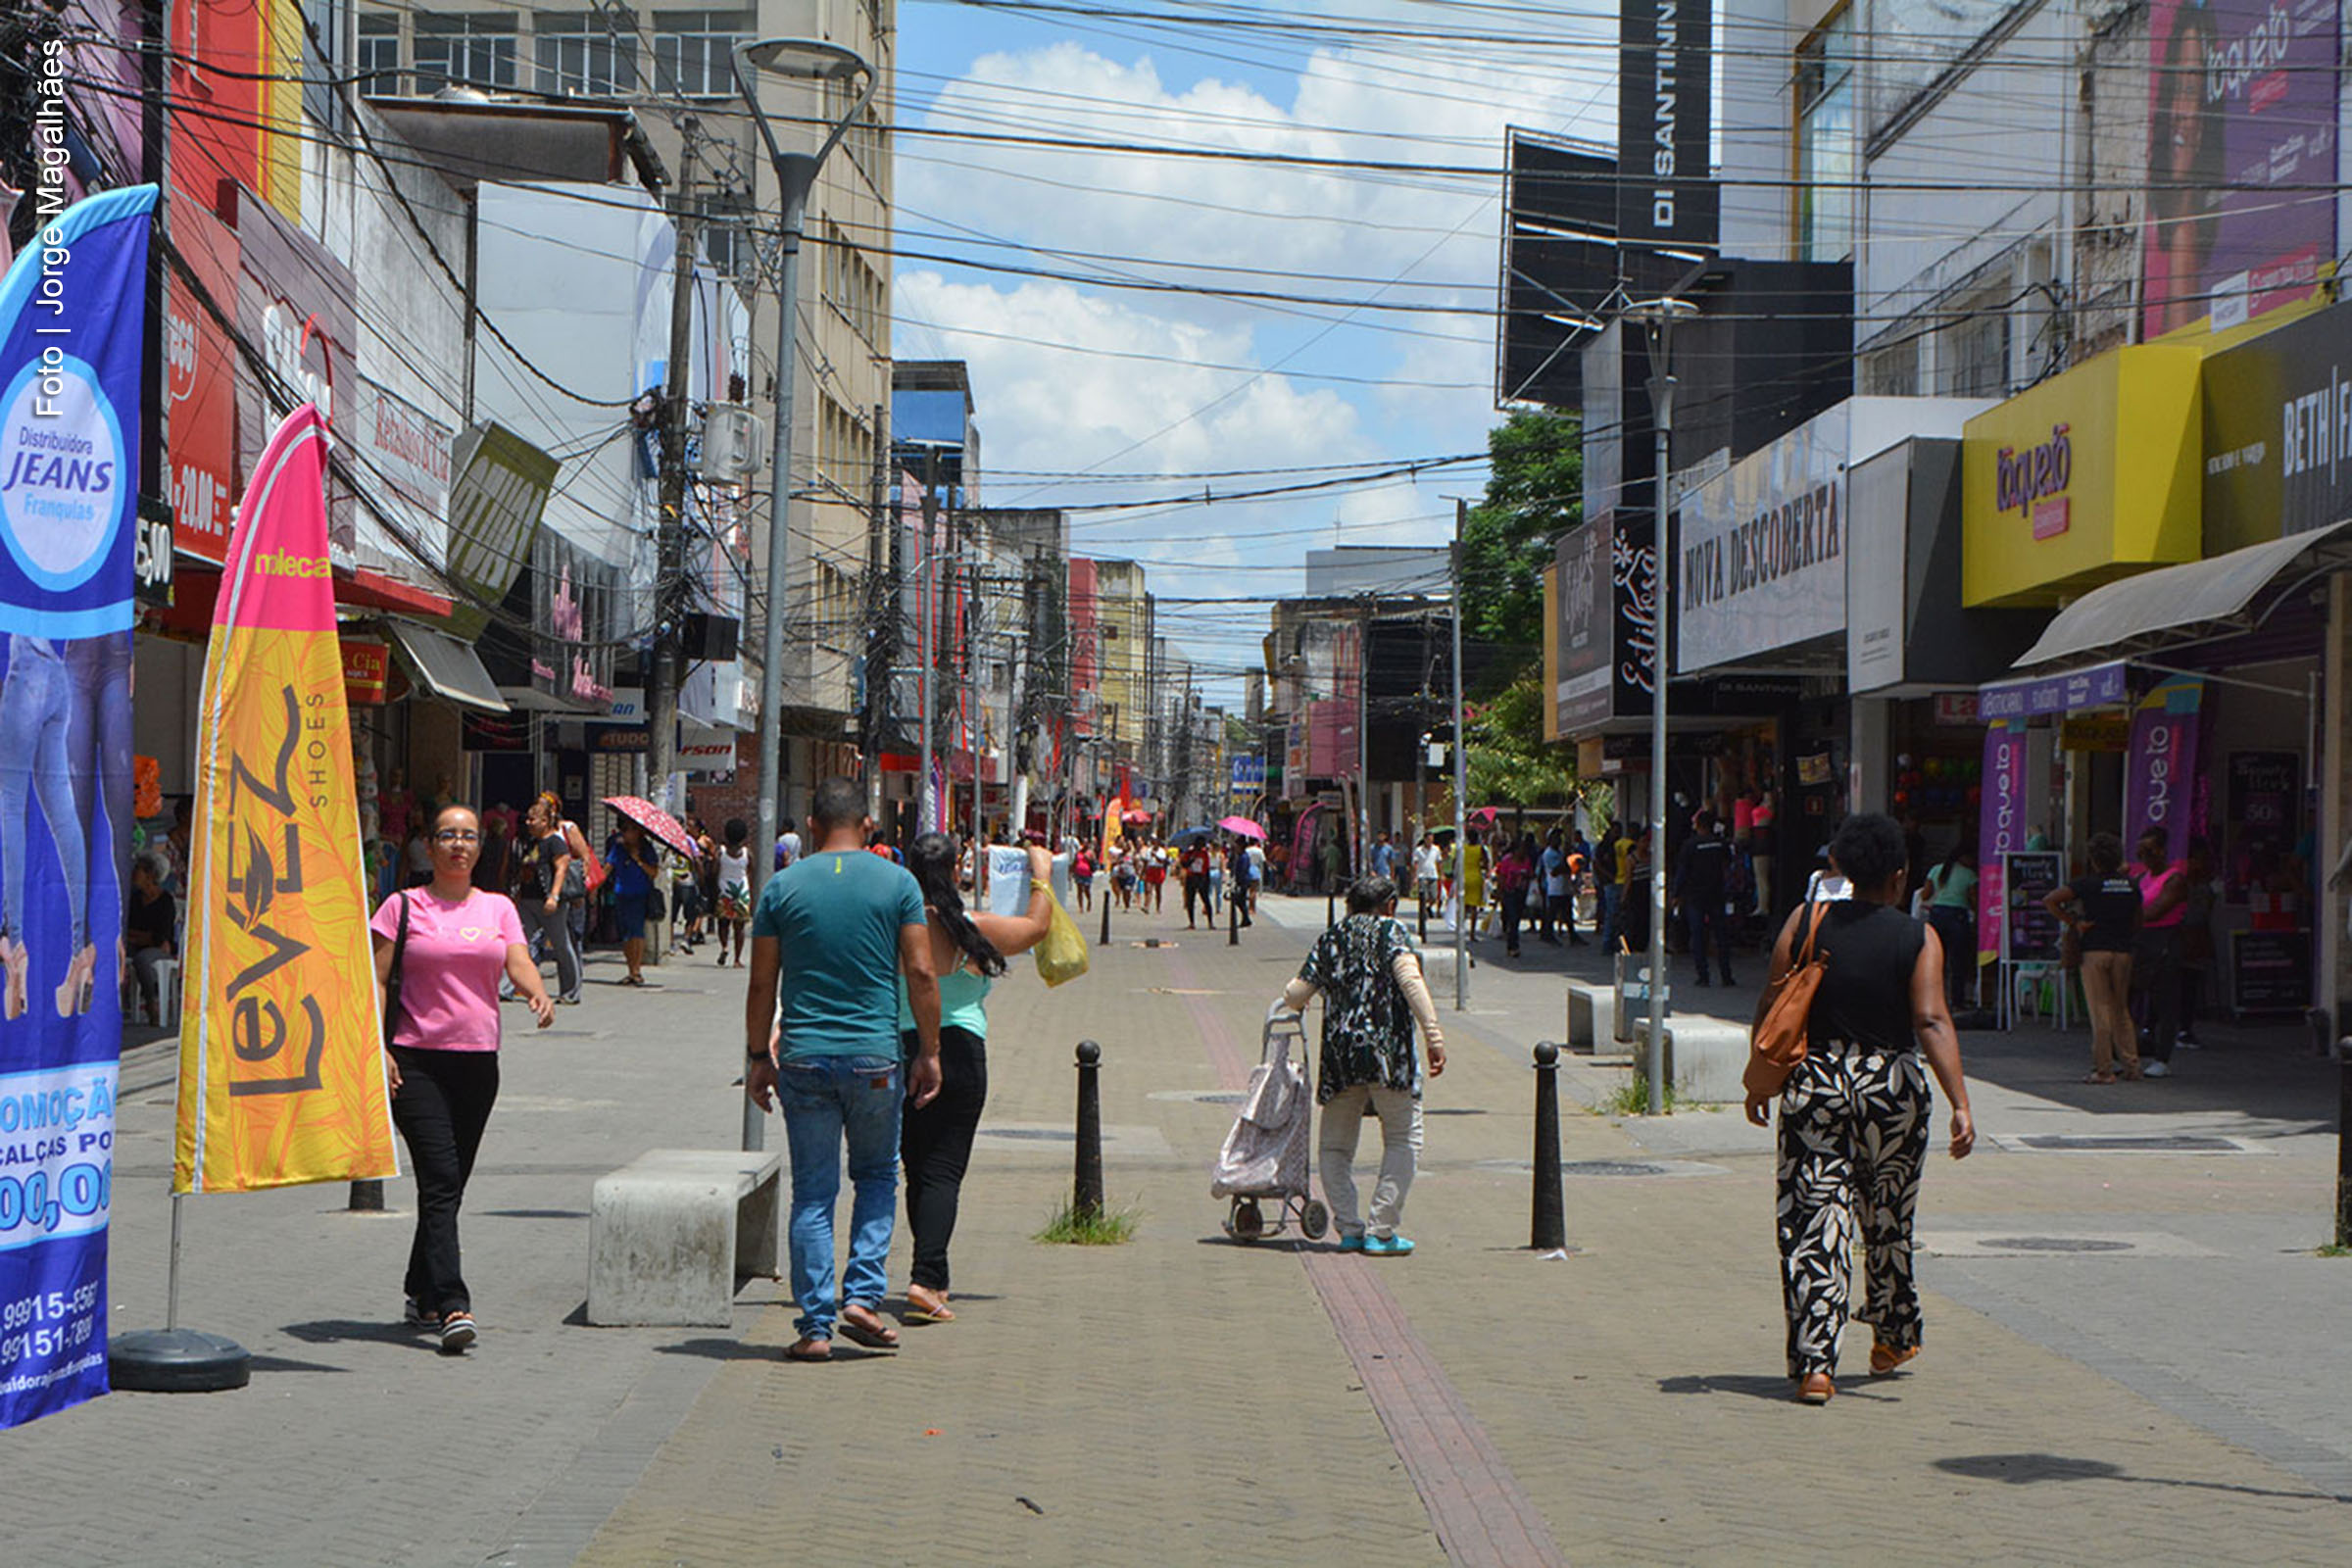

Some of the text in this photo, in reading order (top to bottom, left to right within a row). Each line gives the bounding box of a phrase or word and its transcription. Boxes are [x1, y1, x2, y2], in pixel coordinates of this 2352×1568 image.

[1653, 189, 1675, 227] DI
[19, 426, 93, 456] Distribuidora
[2282, 385, 2330, 479] BETH
[2, 451, 115, 493] JEANS
[23, 492, 95, 522] Franquias
[1685, 535, 1724, 612] NOVA
[1730, 480, 1839, 597] DESCOBERTA
[305, 692, 328, 808] SHOES
[0, 1135, 67, 1166] ALÇAS
